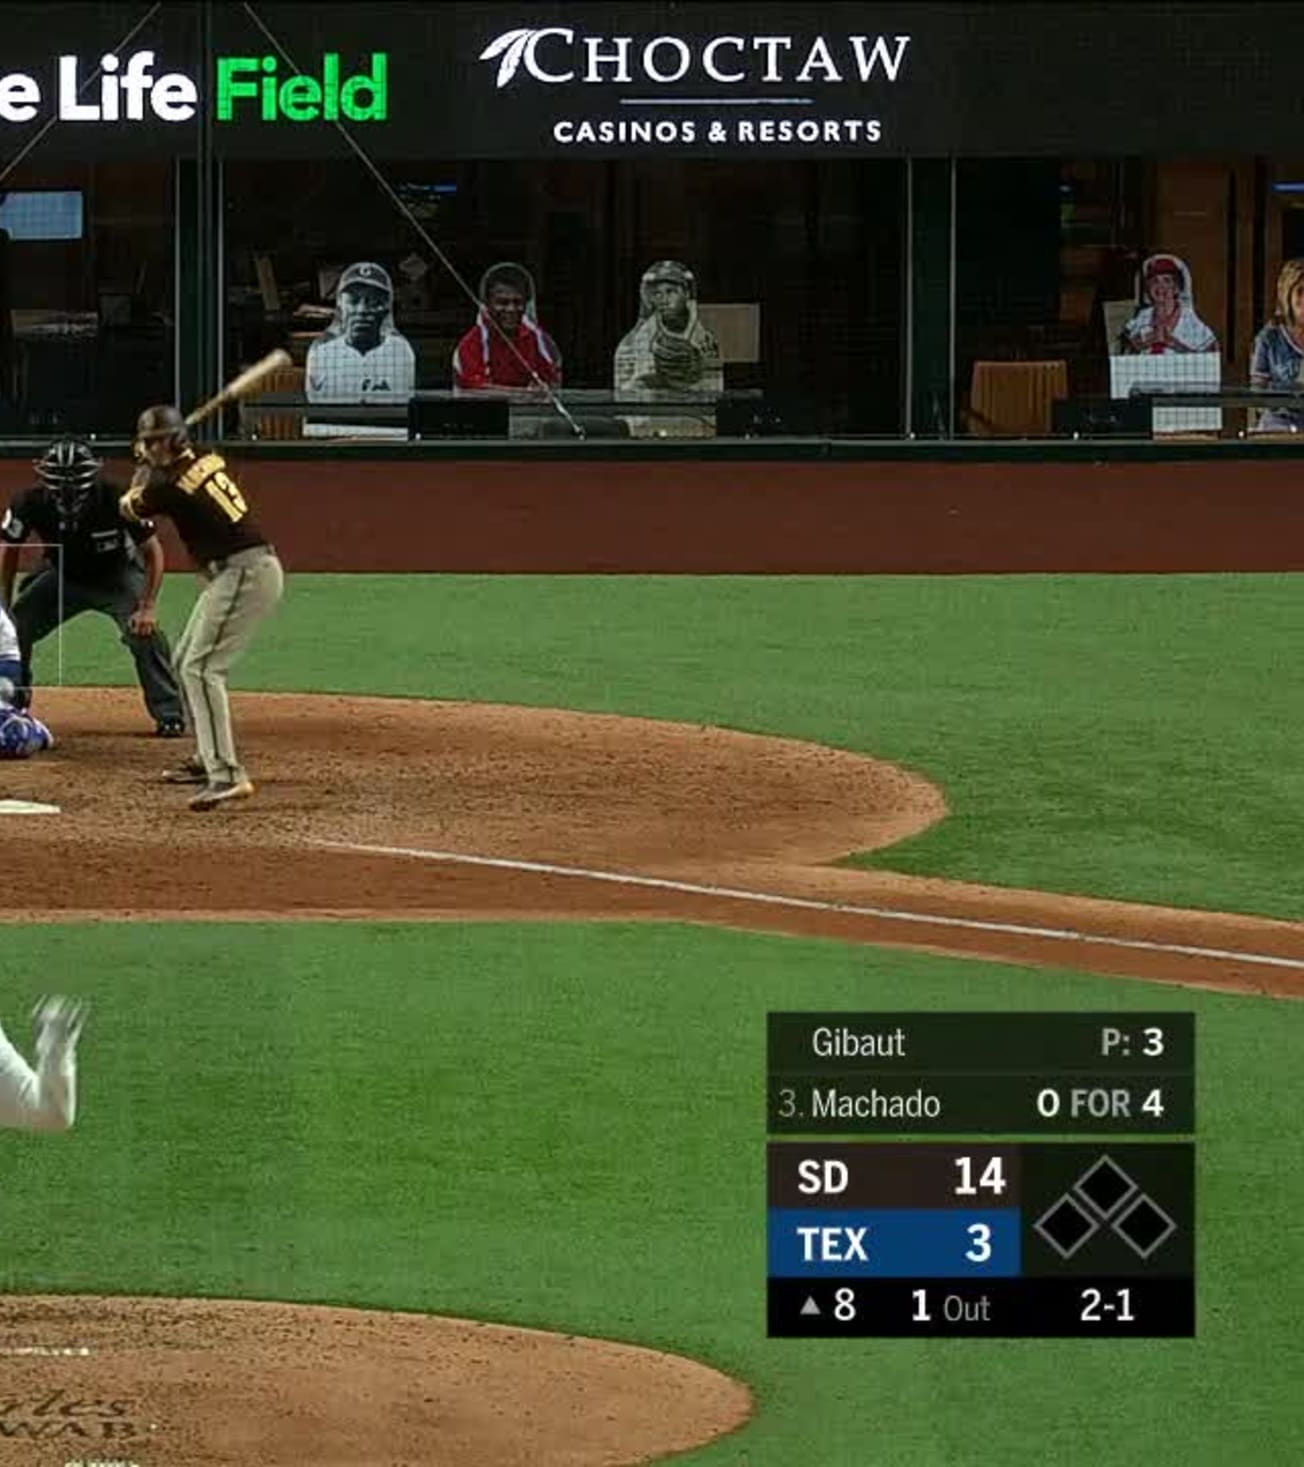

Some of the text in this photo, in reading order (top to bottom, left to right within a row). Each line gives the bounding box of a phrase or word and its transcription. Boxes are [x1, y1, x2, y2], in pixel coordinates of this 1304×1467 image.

[524, 27, 911, 83] CHOCTAW
[59, 50, 198, 122] Life
[217, 52, 387, 121] Field
[553, 119, 881, 143] CASINOS & RESORTS
[204, 471, 248, 523] 13
